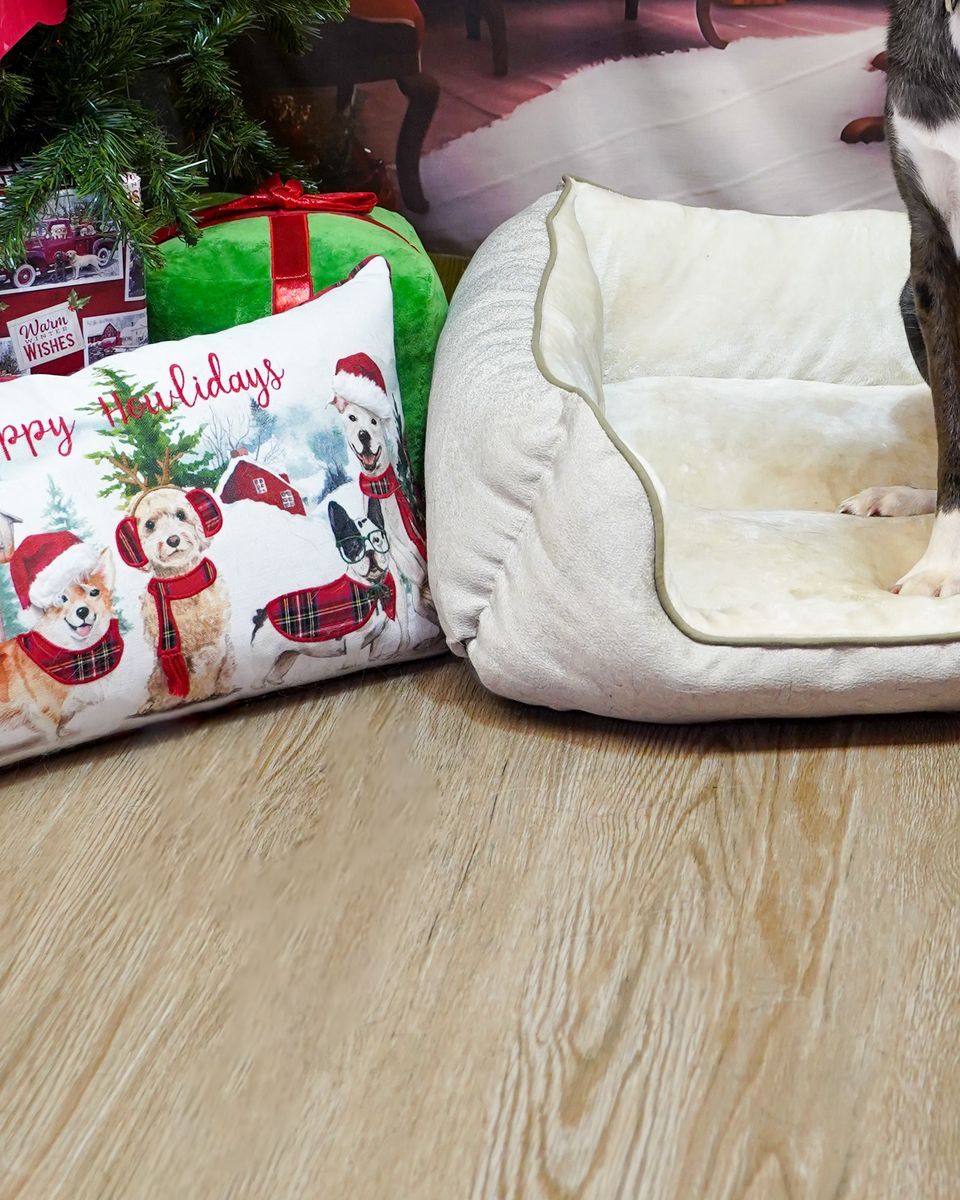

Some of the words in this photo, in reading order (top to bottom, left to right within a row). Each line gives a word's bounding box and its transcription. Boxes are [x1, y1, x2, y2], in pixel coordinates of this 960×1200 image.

[19, 316, 69, 339] Warm
[25, 326, 68, 344] WINTER
[23, 333, 75, 362] WISHES
[98, 352, 285, 428] Howlidays
